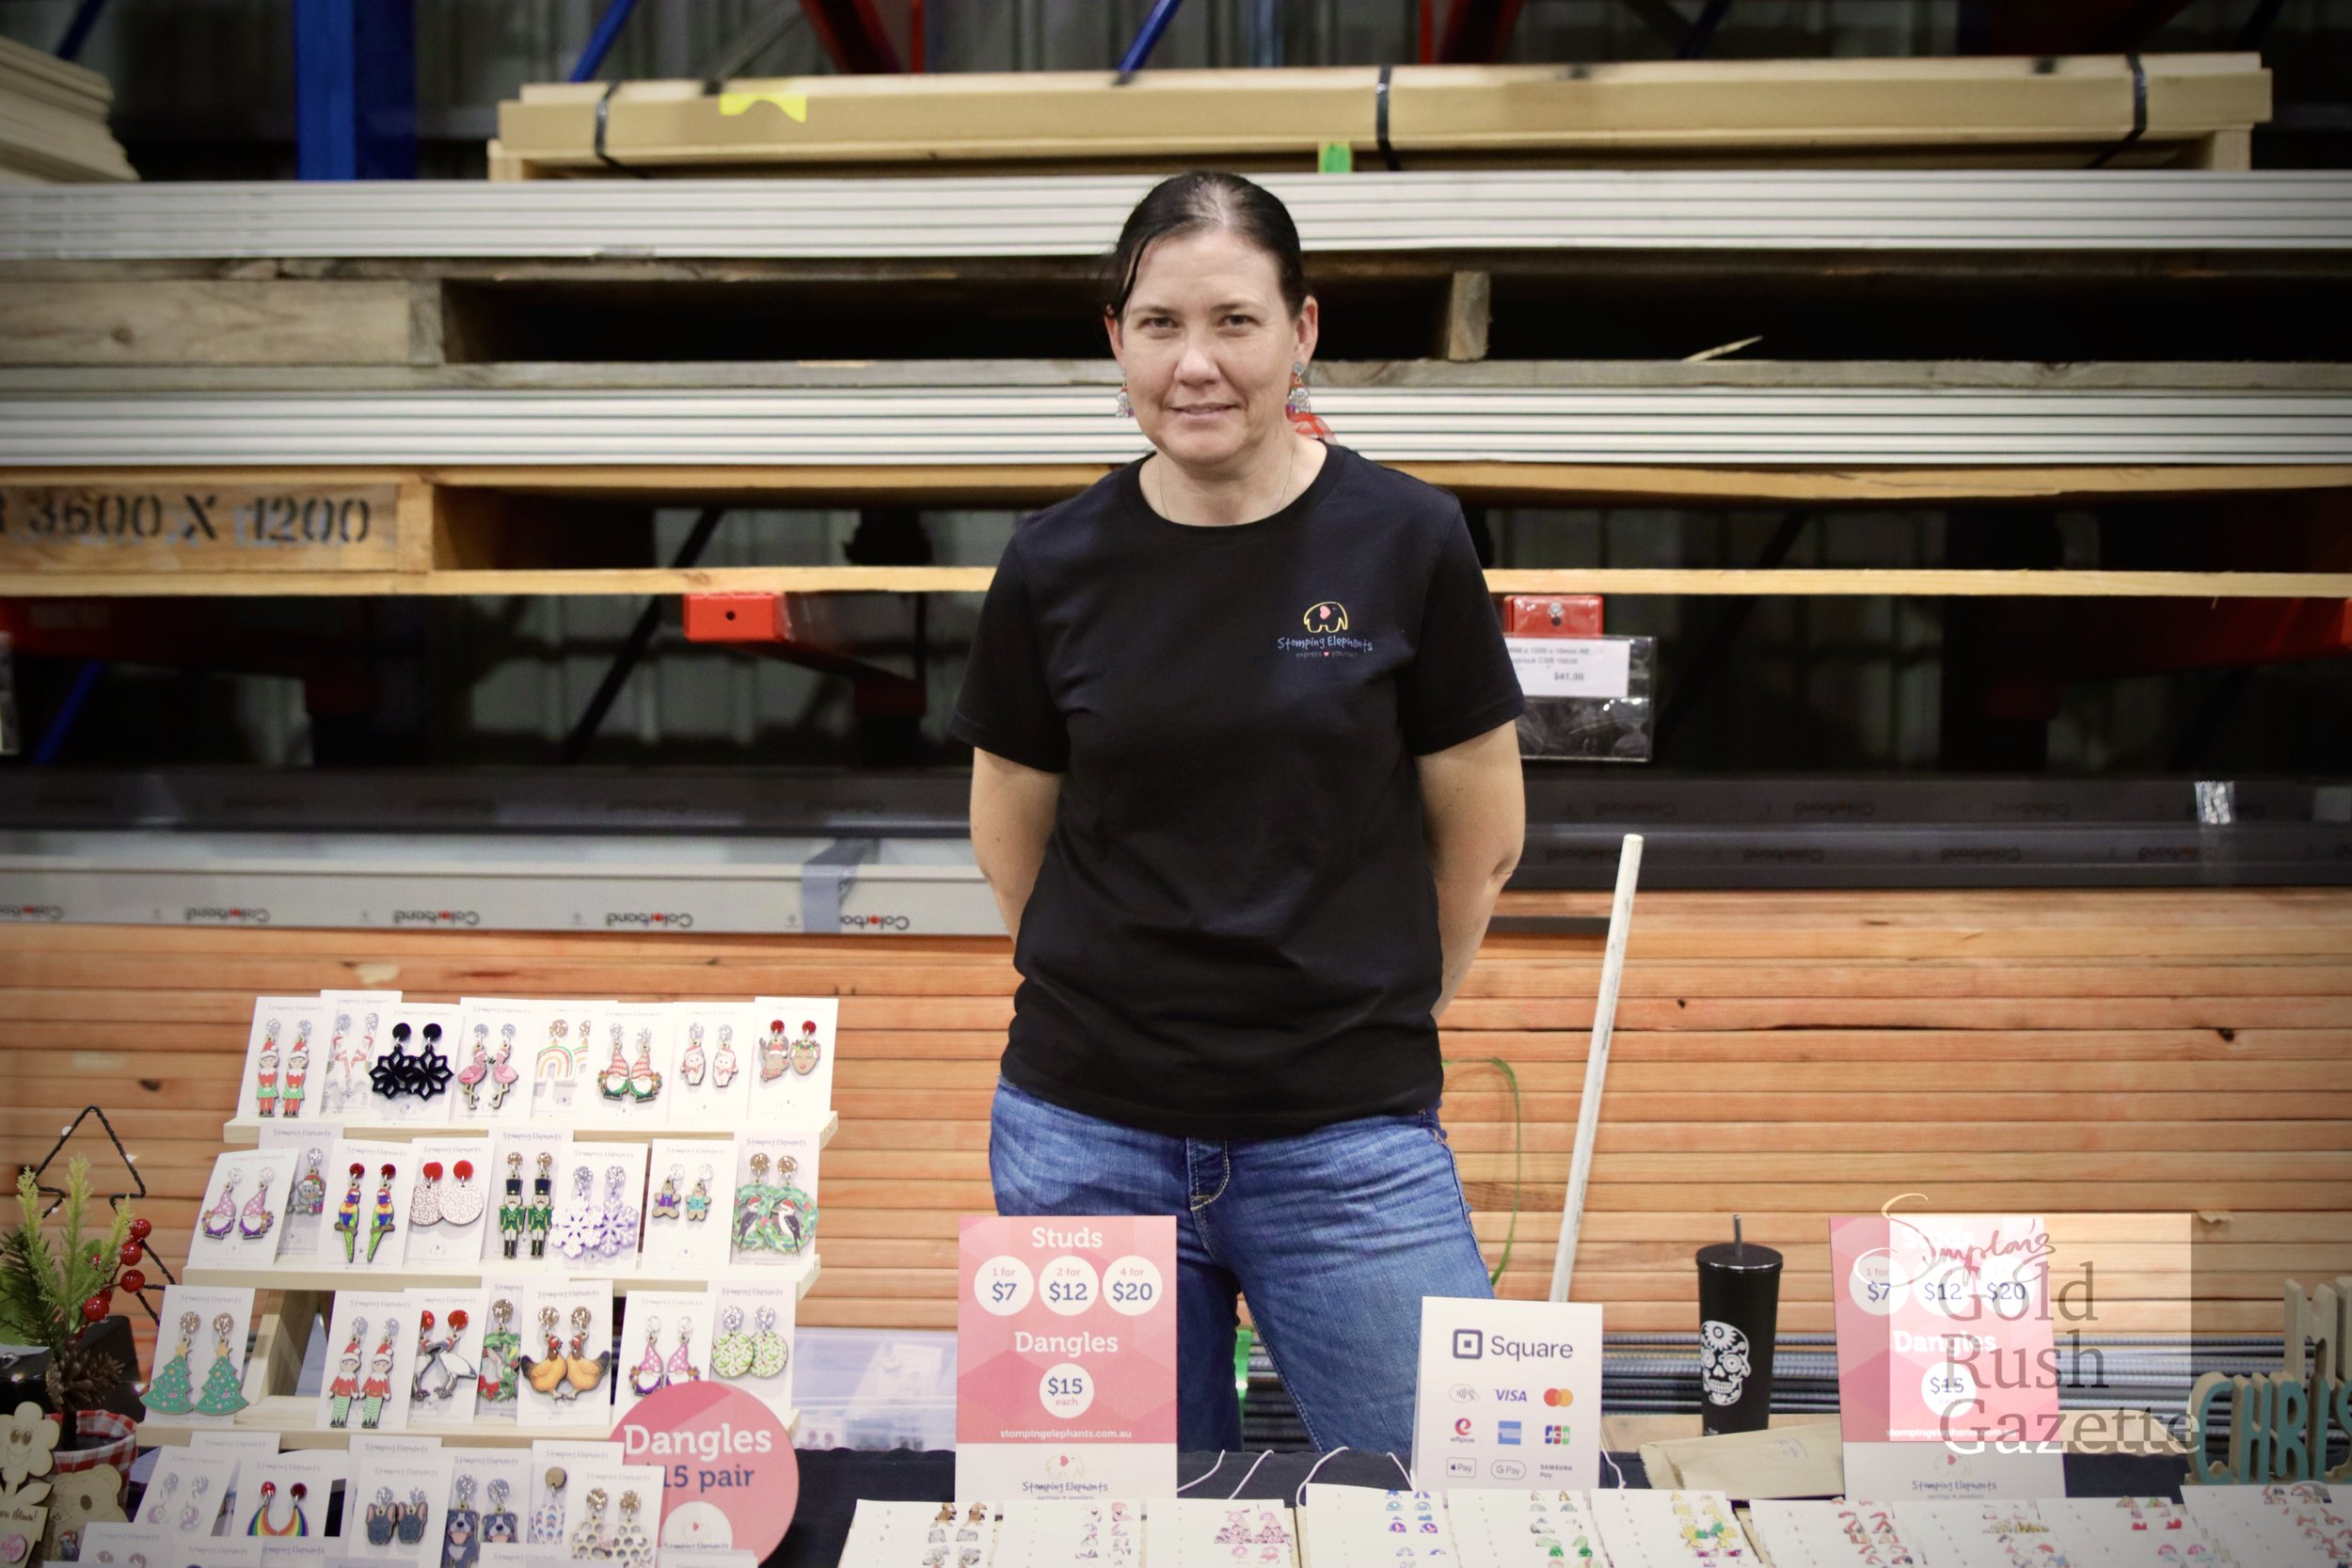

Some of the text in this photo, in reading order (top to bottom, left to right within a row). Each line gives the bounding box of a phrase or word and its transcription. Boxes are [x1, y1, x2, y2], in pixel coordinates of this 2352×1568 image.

[28, 495, 163, 536] 3600
[183, 494, 218, 539] X
[246, 497, 371, 543] 1200
[1278, 635, 1374, 653] Stomping Elephants
[392, 910, 481, 927] Colorbond
[605, 911, 693, 928] Colorbond
[839, 913, 910, 930] Colorbo
[1031, 1227, 1104, 1249] Studs
[993, 1267, 1016, 1277] 1 for
[1057, 1267, 1081, 1277] 2 for
[1120, 1267, 1145, 1277] 4 for
[992, 1280, 1017, 1303] $7
[1049, 1280, 1089, 1303] $12
[1112, 1280, 1153, 1303] $20
[1867, 1281, 1891, 1302] $7
[1924, 1281, 1963, 1302] $12
[1987, 1281, 2026, 1302] $20
[1014, 1332, 1119, 1358] Dangles
[1490, 1336, 1574, 1362] Square
[1047, 1376, 1084, 1397] $15
[1495, 1388, 1528, 1402] VISA
[1930, 1375, 1965, 1395] $15
[1056, 1398, 1079, 1406] each
[624, 1423, 772, 1461] Dangles
[1000, 1429, 1133, 1440] stompingelephants.com.au
[1457, 1463, 1472, 1474] Pay
[1505, 1465, 1521, 1476] Pay
[662, 1464, 755, 1494] 15 pair
[1022, 1481, 1108, 1493] Stomping Elephants
